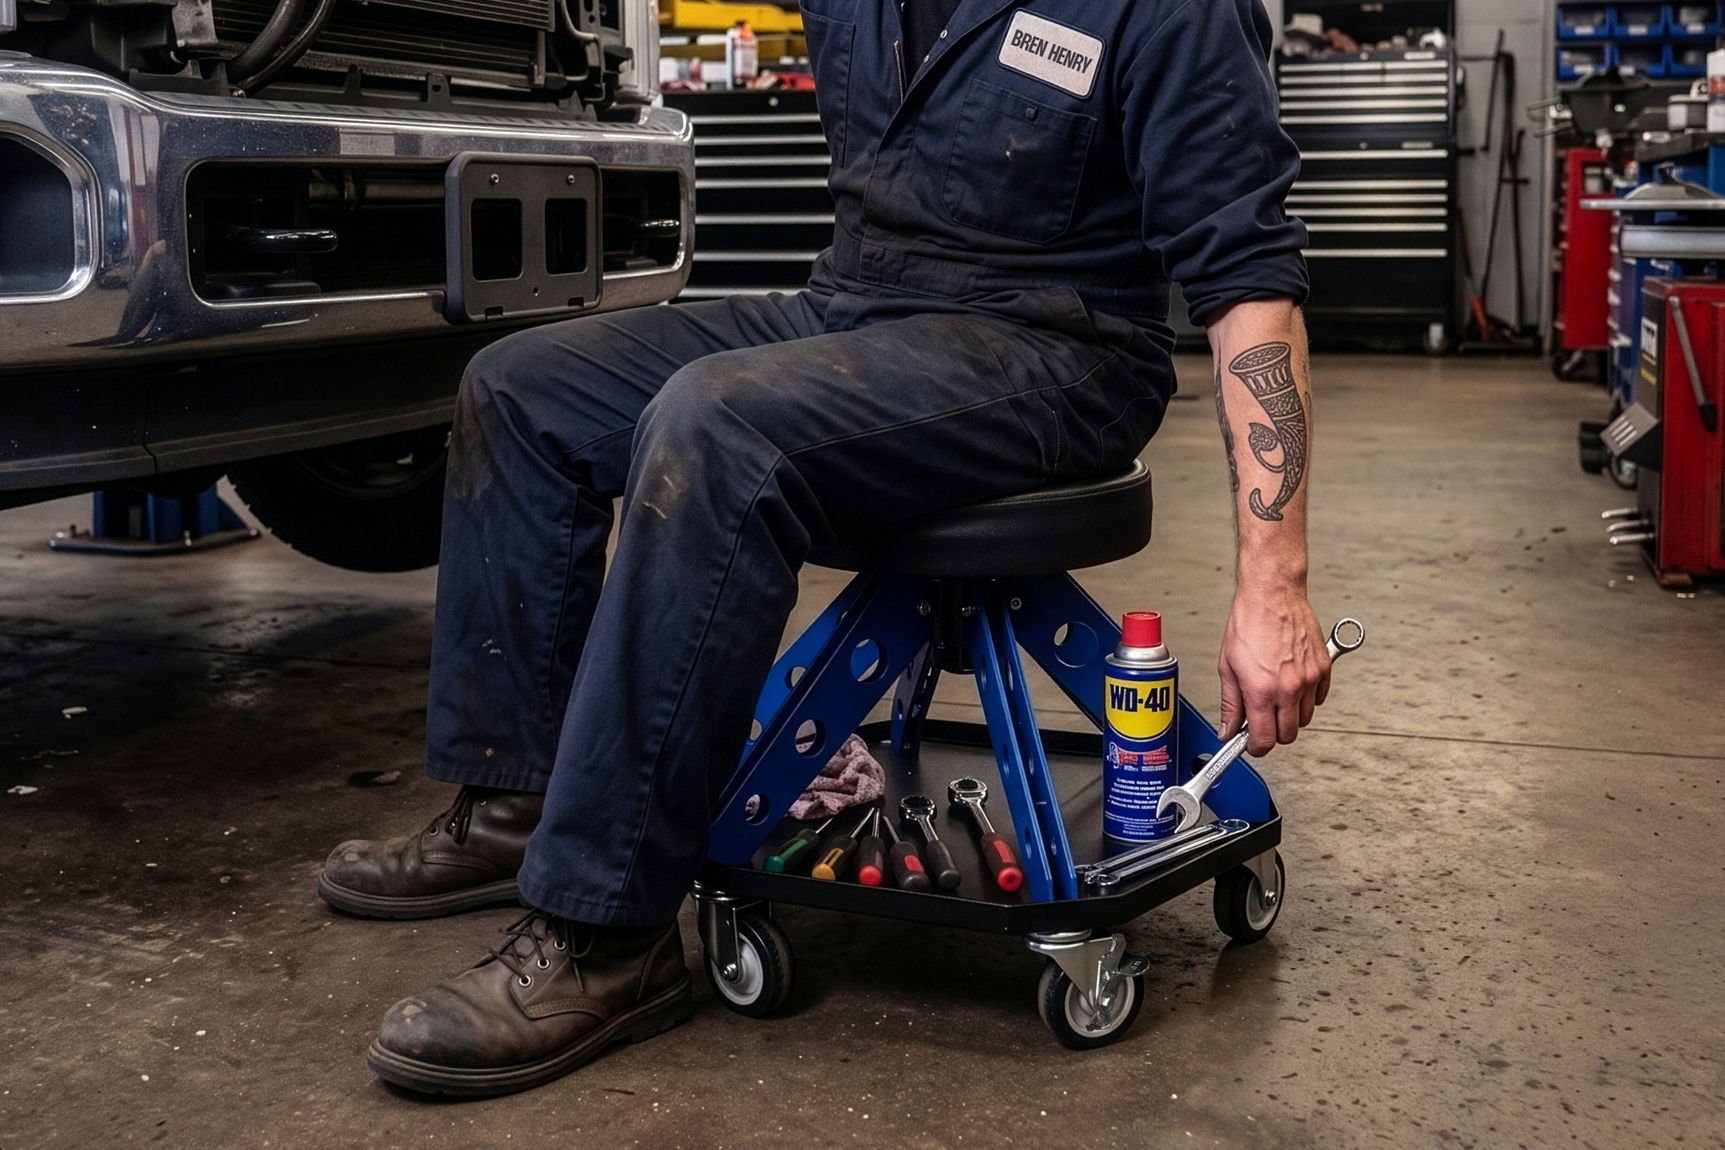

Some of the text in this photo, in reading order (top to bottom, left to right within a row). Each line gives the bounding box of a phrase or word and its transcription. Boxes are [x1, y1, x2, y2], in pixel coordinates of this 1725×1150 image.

[1010, 29, 1093, 74] BREN HENRY
[1110, 683, 1170, 712] WD-40
